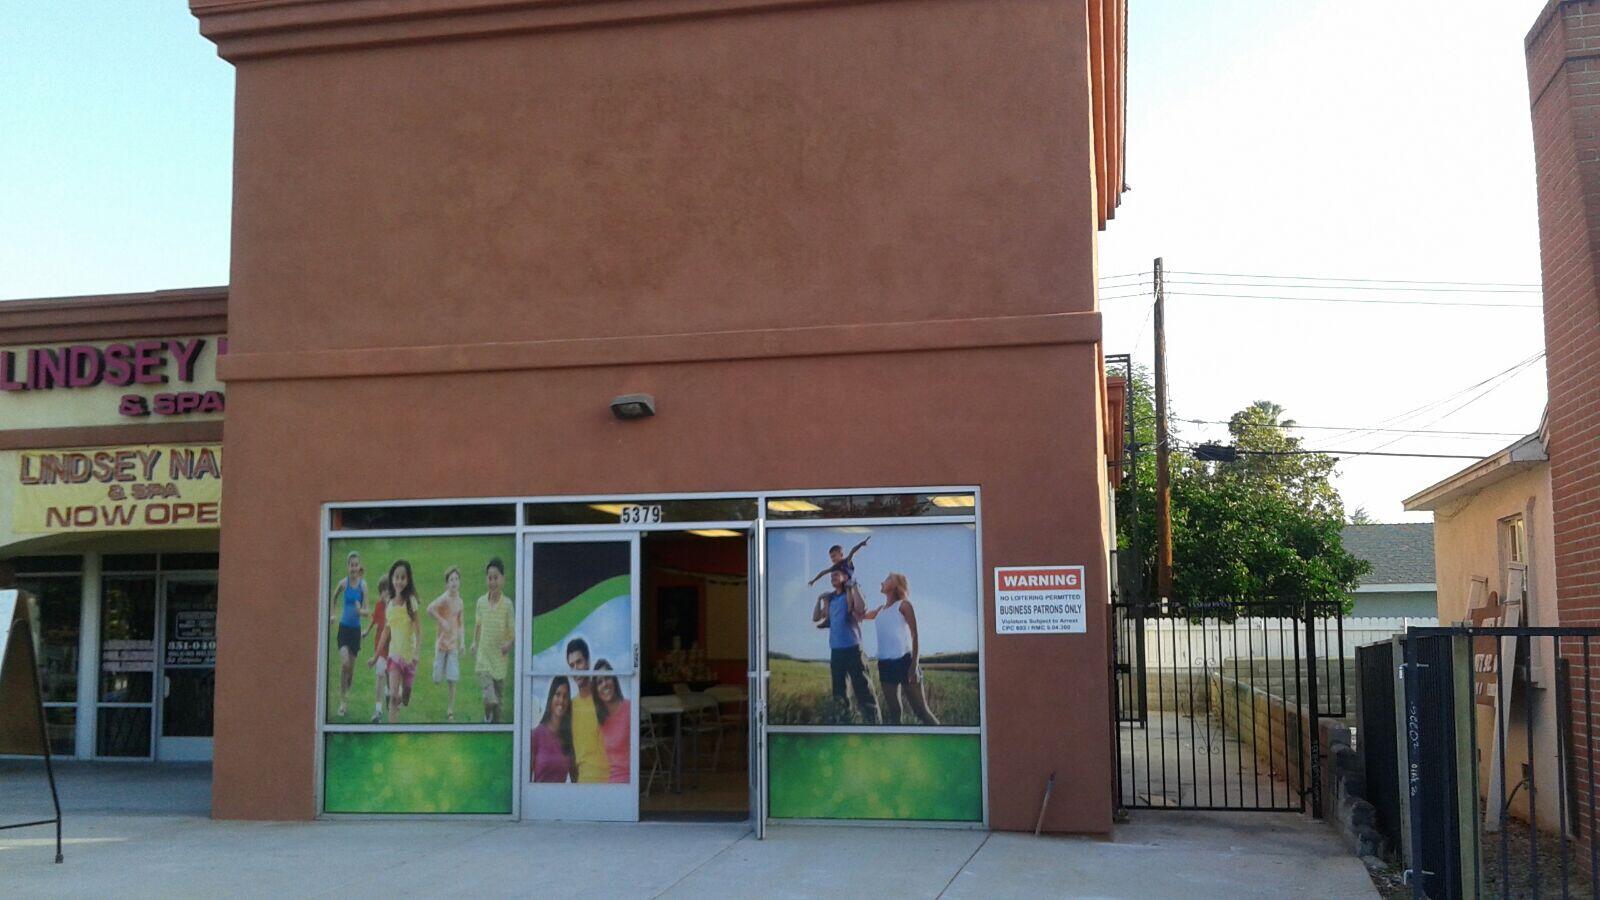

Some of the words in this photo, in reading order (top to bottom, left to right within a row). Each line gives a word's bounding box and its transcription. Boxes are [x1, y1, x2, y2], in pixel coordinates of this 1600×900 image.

[0, 338, 205, 391] LINDSEY
[118, 393, 150, 416] &
[153, 390, 224, 416] SPA
[20, 449, 161, 484] LINDSEY
[107, 484, 127, 501] &
[130, 482, 181, 500] SPA
[45, 504, 137, 528] NOW
[622, 506, 660, 523] 5379
[1003, 574, 1077, 586] WARNING
[1000, 605, 1032, 615] BUSINESS
[1033, 604, 1063, 614] PATRONS
[1065, 604, 1082, 613] ONLY
